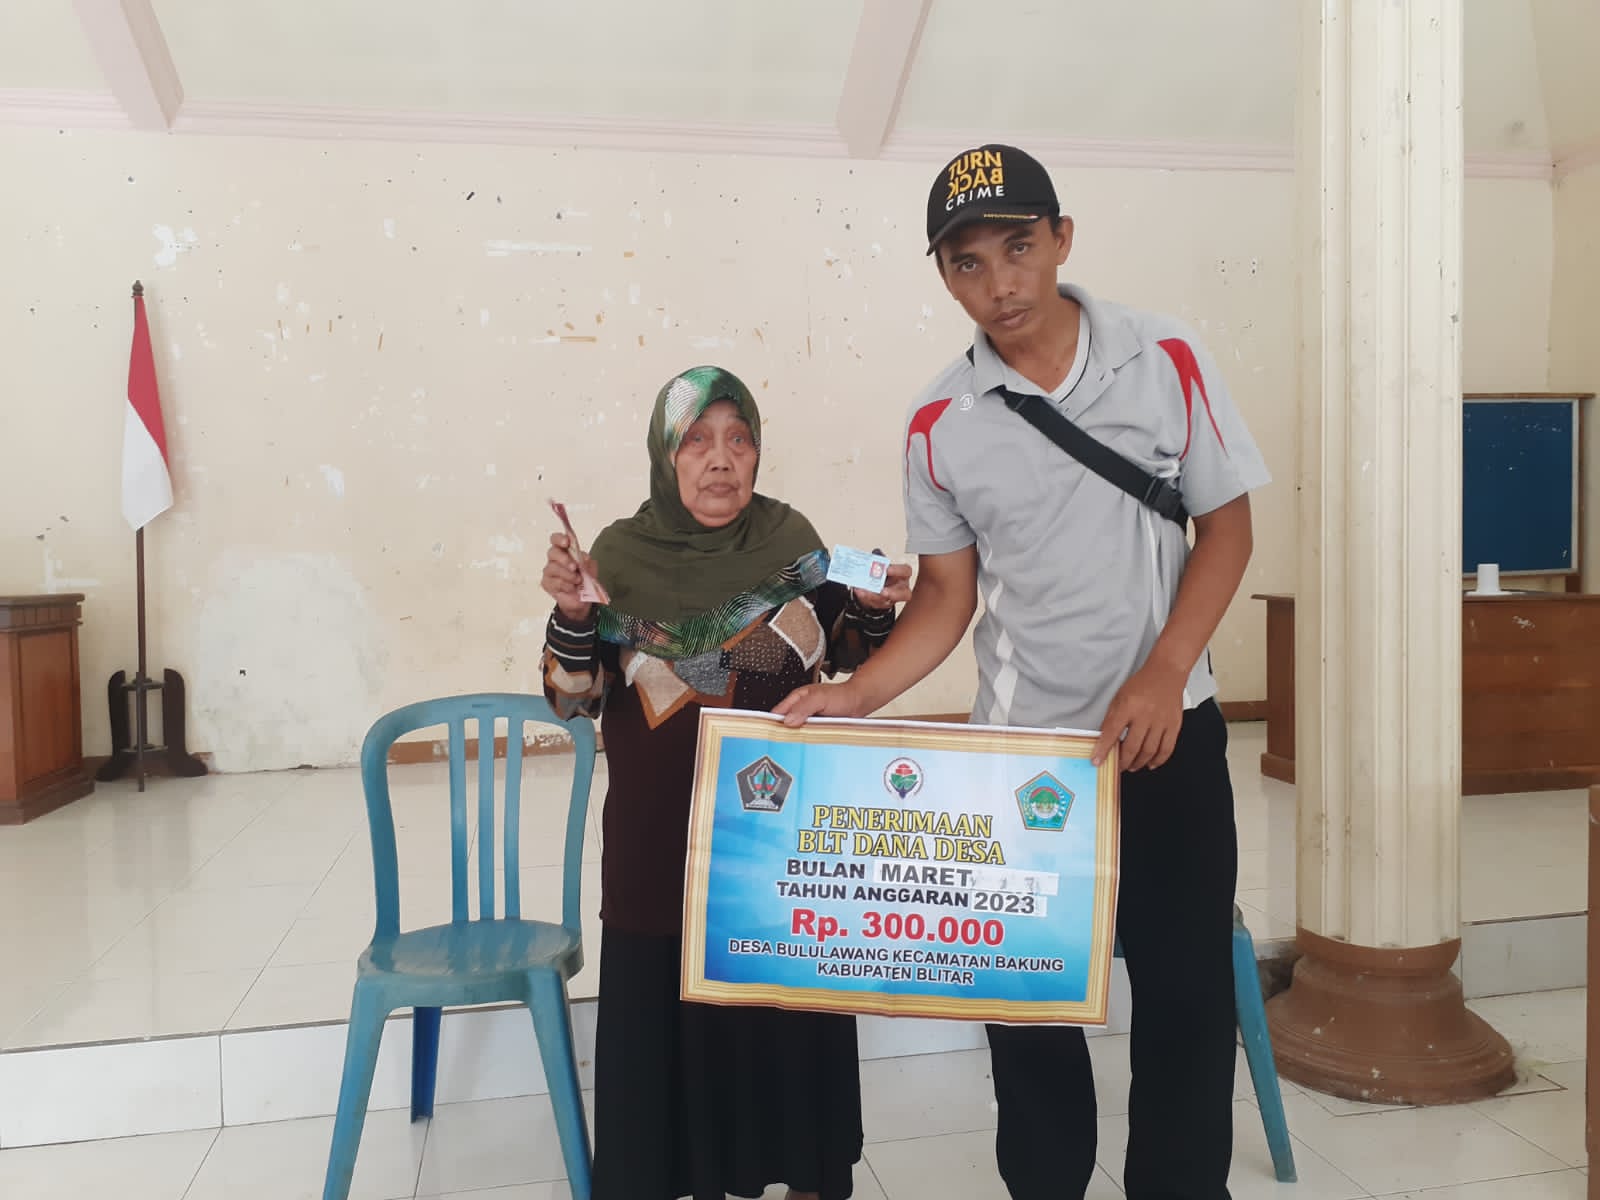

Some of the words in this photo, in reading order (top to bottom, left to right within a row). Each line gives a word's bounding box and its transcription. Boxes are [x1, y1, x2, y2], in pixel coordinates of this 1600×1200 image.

[948, 150, 1003, 180] TURN
[945, 185, 1005, 211] CRIME
[812, 805, 993, 838] PENERIMAAN
[797, 830, 847, 854] BLT
[853, 833, 928, 860] DANA
[934, 840, 1006, 865] DESA
[787, 859, 865, 880] BULAN
[880, 863, 972, 888] MARET
[776, 881, 847, 900] TAHUN
[853, 886, 968, 908] ANGGARAN
[973, 892, 1036, 914] 2023
[791, 908, 849, 942] Rp.
[861, 911, 1005, 946] 300.000
[729, 939, 773, 954] DESA
[776, 942, 889, 961] BULULAWANG
[892, 949, 991, 969] KECAMATAN
[995, 955, 1064, 972] BAKUNG
[817, 962, 912, 980] KABUPATEN
[916, 967, 974, 985] BLITAR
